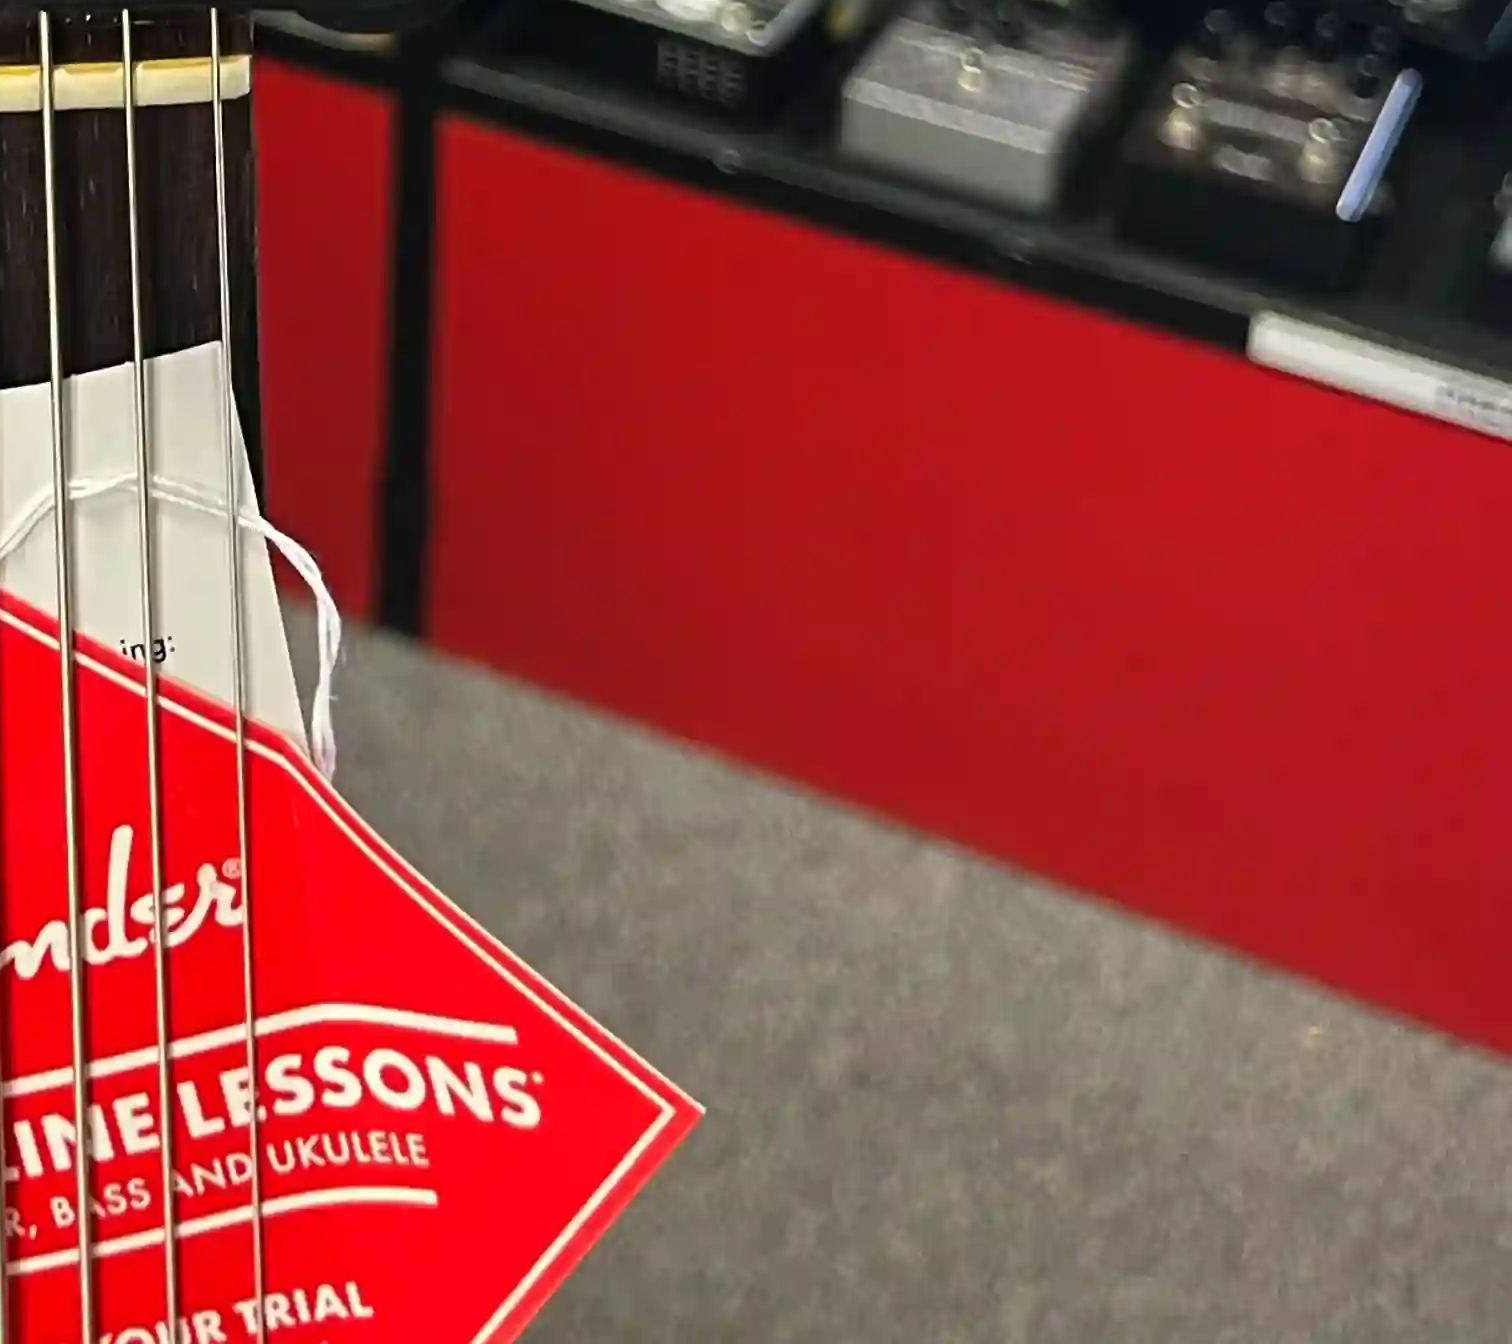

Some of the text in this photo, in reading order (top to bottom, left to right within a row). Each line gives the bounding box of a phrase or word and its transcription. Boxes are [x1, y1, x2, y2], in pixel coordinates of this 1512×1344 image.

[171, 1152, 254, 1199] AND
[266, 1130, 430, 1173] UKULELE
[233, 1281, 375, 1335] TRIAL
